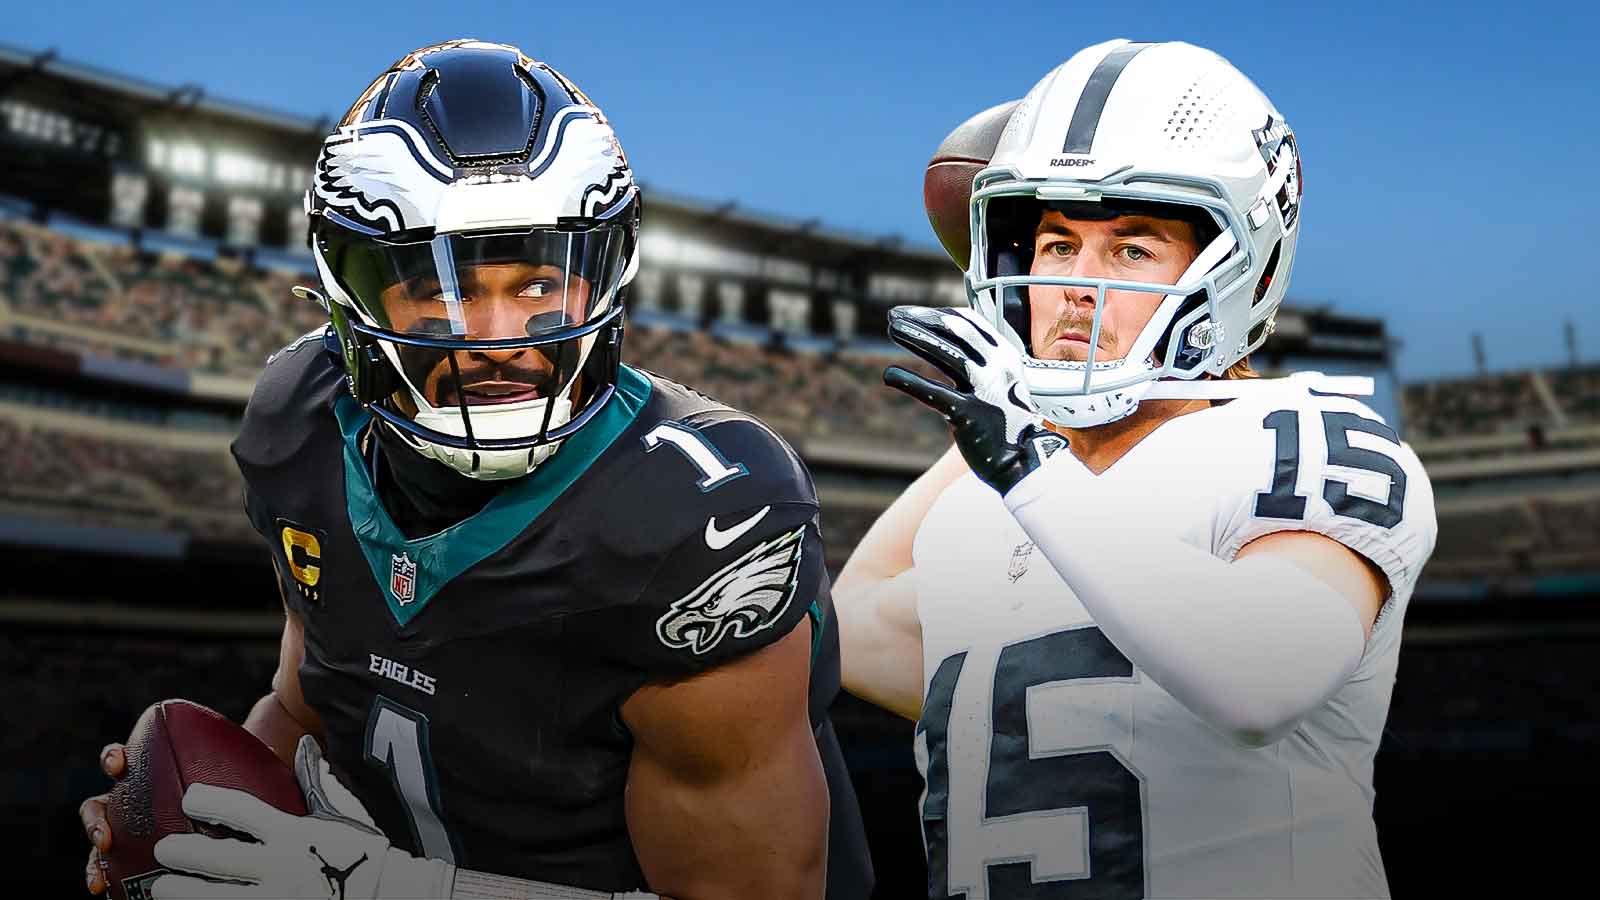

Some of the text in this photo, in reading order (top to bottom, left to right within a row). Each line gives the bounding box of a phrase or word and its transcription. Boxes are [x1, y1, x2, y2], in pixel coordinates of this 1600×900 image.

[640, 420, 749, 493] 1
[1254, 409, 1407, 530] 15
[282, 526, 321, 587] C
[368, 653, 437, 696] EAGLES
[364, 694, 458, 866] 1
[917, 624, 1145, 900] 15
